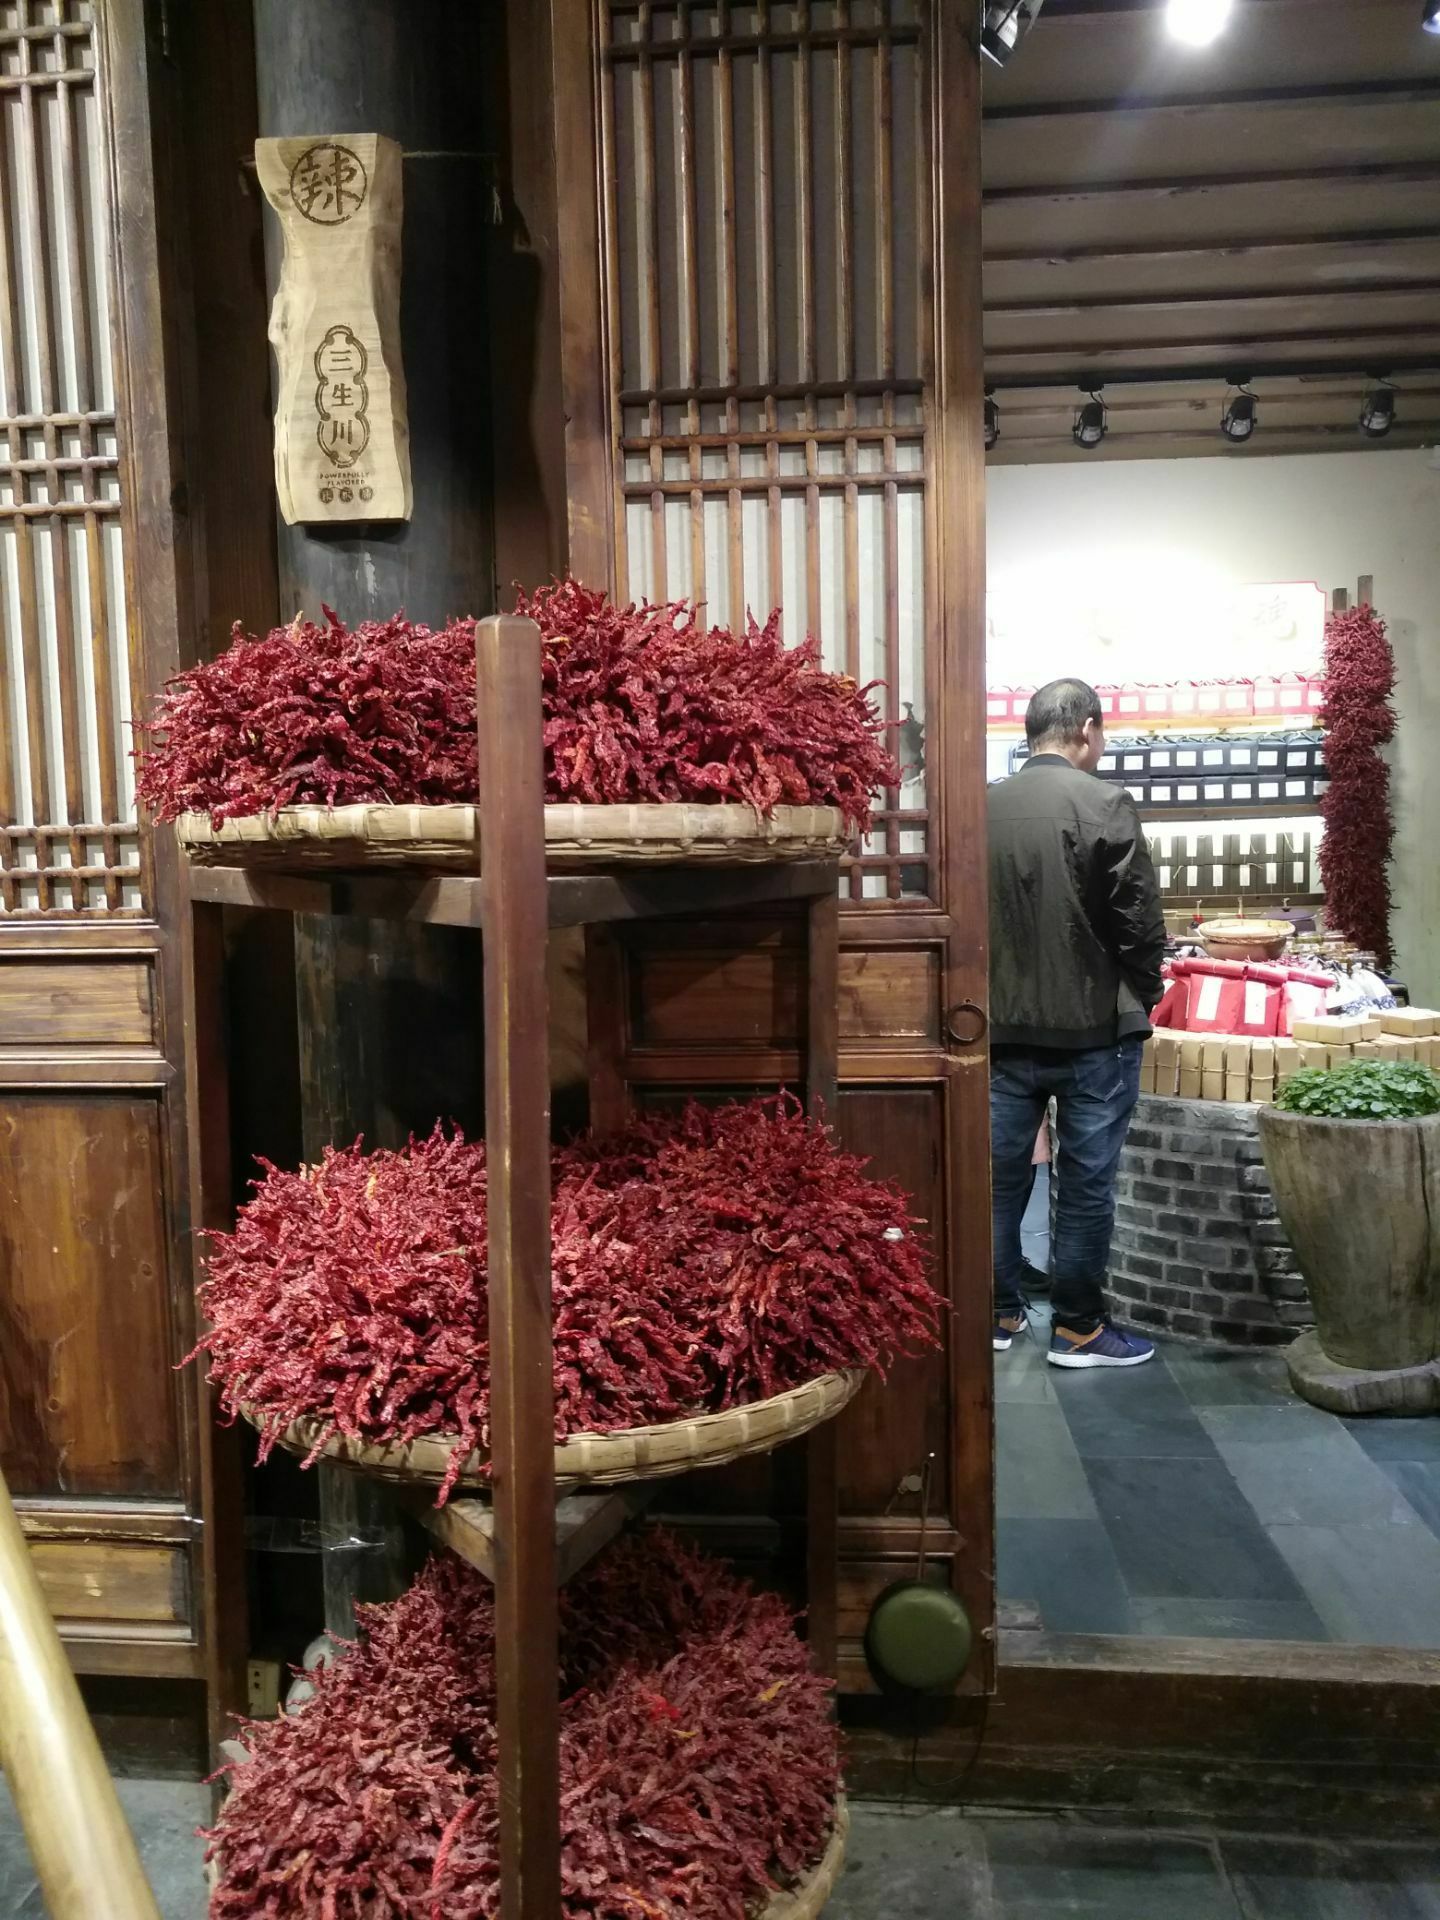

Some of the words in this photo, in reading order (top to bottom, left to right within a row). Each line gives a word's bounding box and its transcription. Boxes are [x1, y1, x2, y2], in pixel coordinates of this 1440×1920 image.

[300, 150, 363, 216] 辣
[328, 349, 355, 445] 三生川
